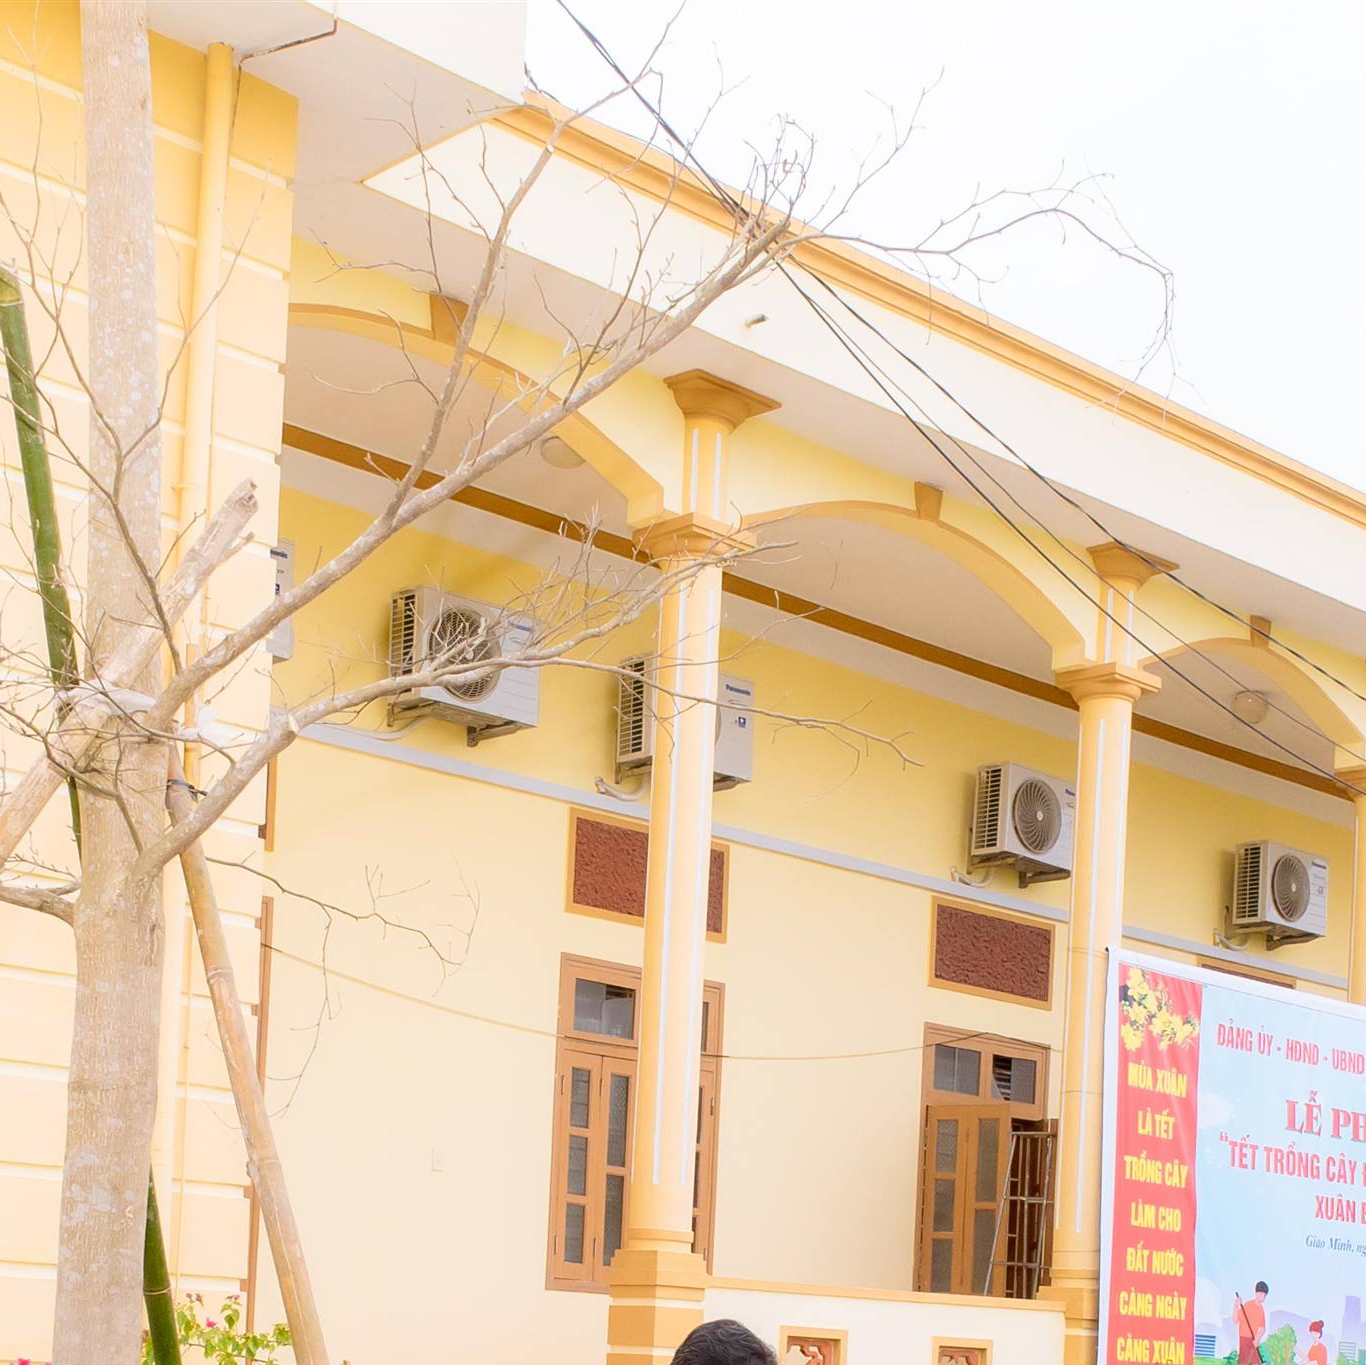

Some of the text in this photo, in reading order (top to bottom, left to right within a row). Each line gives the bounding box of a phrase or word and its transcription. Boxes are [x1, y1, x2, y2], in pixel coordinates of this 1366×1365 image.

[1217, 1018, 1253, 1052] ĐẢNG
[1258, 1025, 1273, 1056] ỦY
[1332, 1048, 1365, 1075] UBND
[1127, 1059, 1187, 1098] MÙA XUÂN
[1138, 1107, 1175, 1140] LÀ TẾT
[1285, 1090, 1323, 1136] LỄ
[1123, 1150, 1188, 1189] TRỒNG CÂY
[1263, 1141, 1321, 1180] TRỒNG
[1326, 1152, 1357, 1185] CÂY
[1131, 1198, 1182, 1232] LÀM CHO
[1315, 1193, 1356, 1223] XUÂN
[1126, 1240, 1184, 1277] ĐẤT NƯỚC
[1305, 1234, 1326, 1248] Giao
[1119, 1287, 1187, 1320] CÀNG NGÀY
[1116, 1333, 1185, 1365] CÀNG XUÂN
